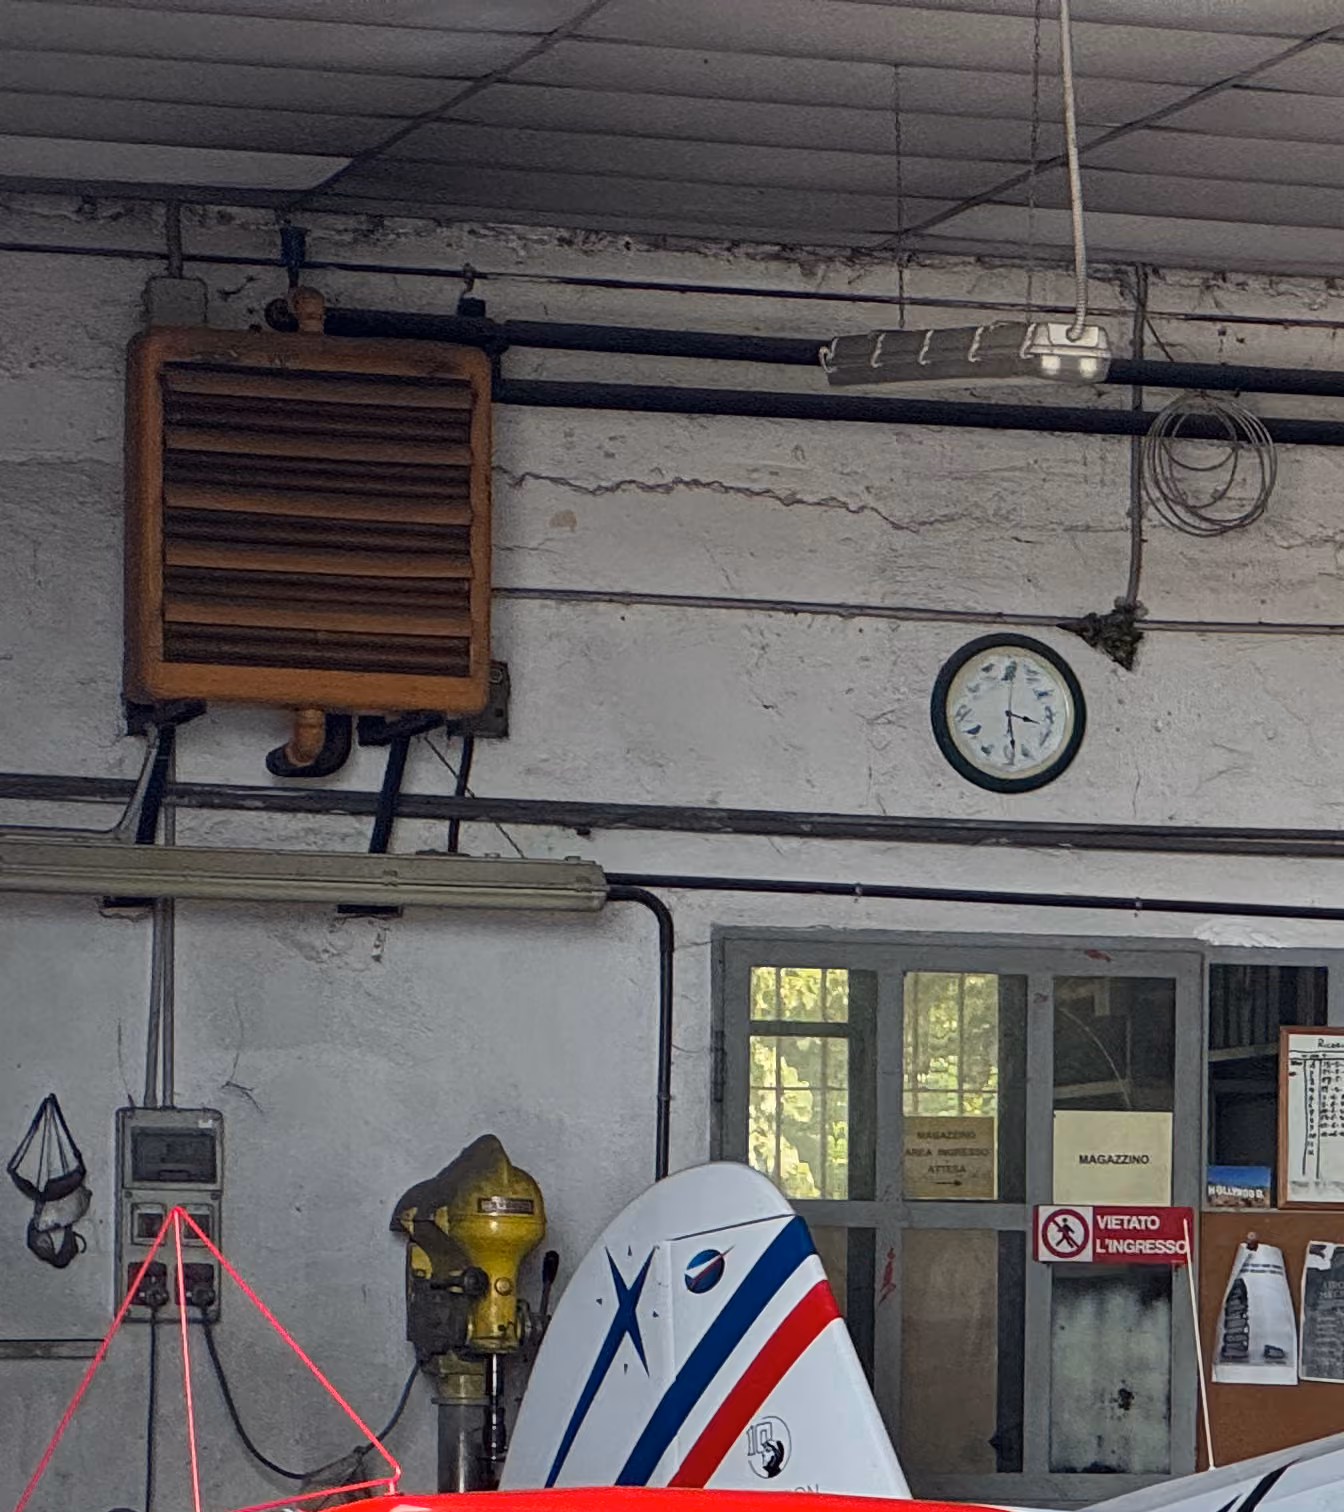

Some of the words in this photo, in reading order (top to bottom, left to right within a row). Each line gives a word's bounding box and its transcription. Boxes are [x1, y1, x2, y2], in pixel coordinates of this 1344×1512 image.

[1078, 1154, 1150, 1165] MAGAZZINO
[1095, 1215, 1161, 1231] VIETATO
[1095, 1238, 1188, 1255] L'INGRESSO
